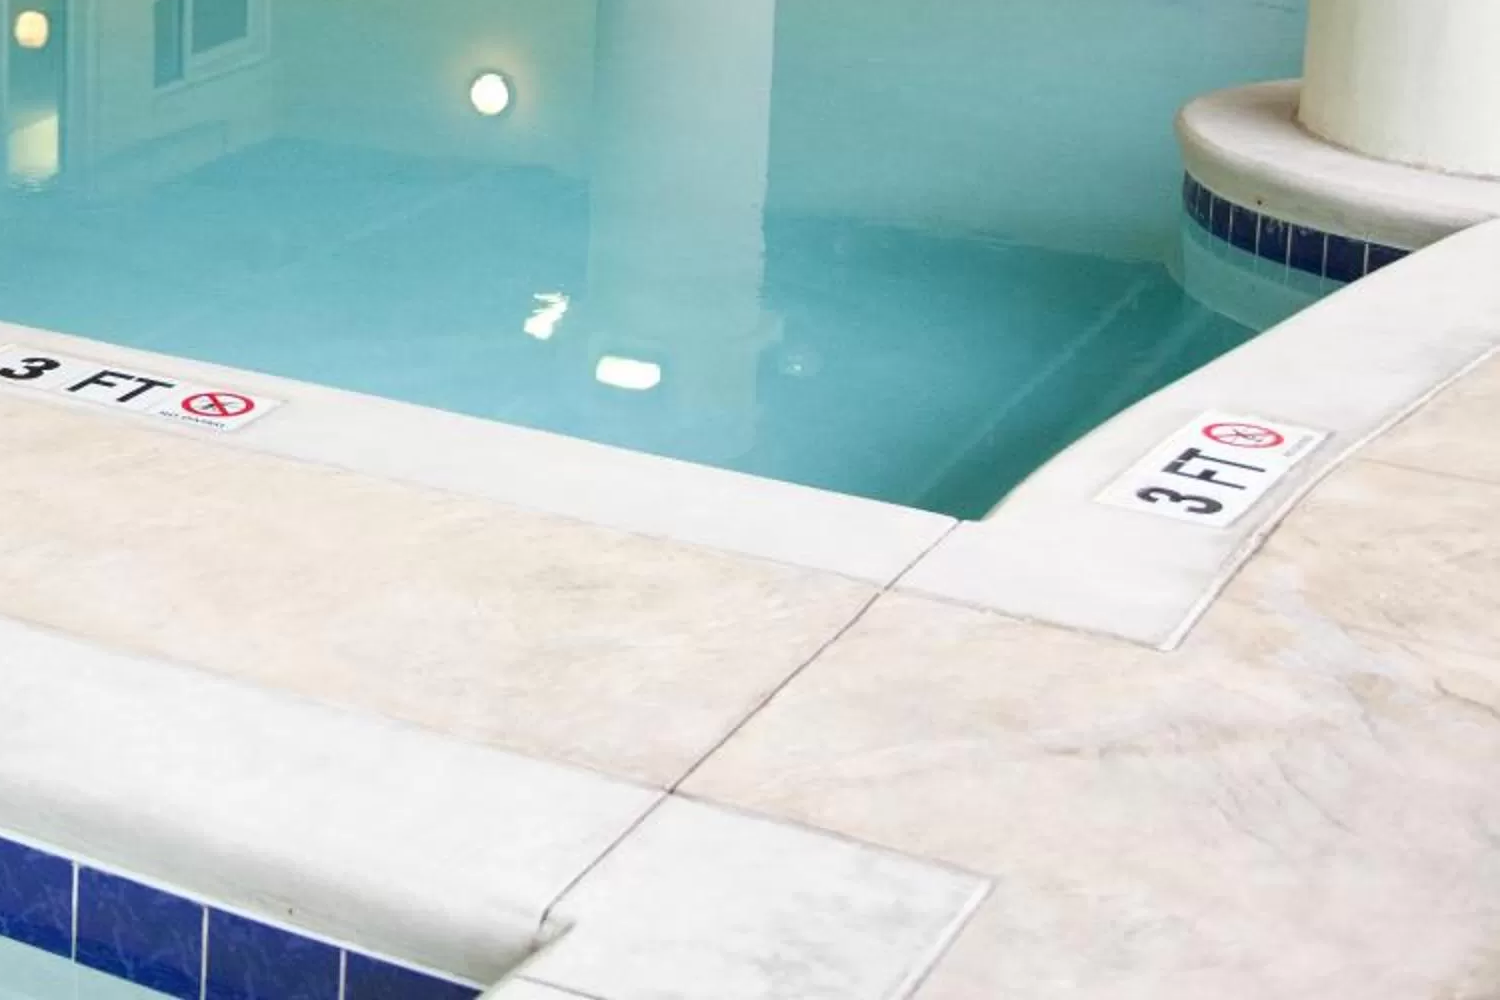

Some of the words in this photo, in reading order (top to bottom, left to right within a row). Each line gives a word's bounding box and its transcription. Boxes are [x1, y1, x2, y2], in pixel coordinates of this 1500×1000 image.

[66, 369, 176, 403] FT
[1160, 447, 1267, 491] FT
[1135, 486, 1223, 515] 3
